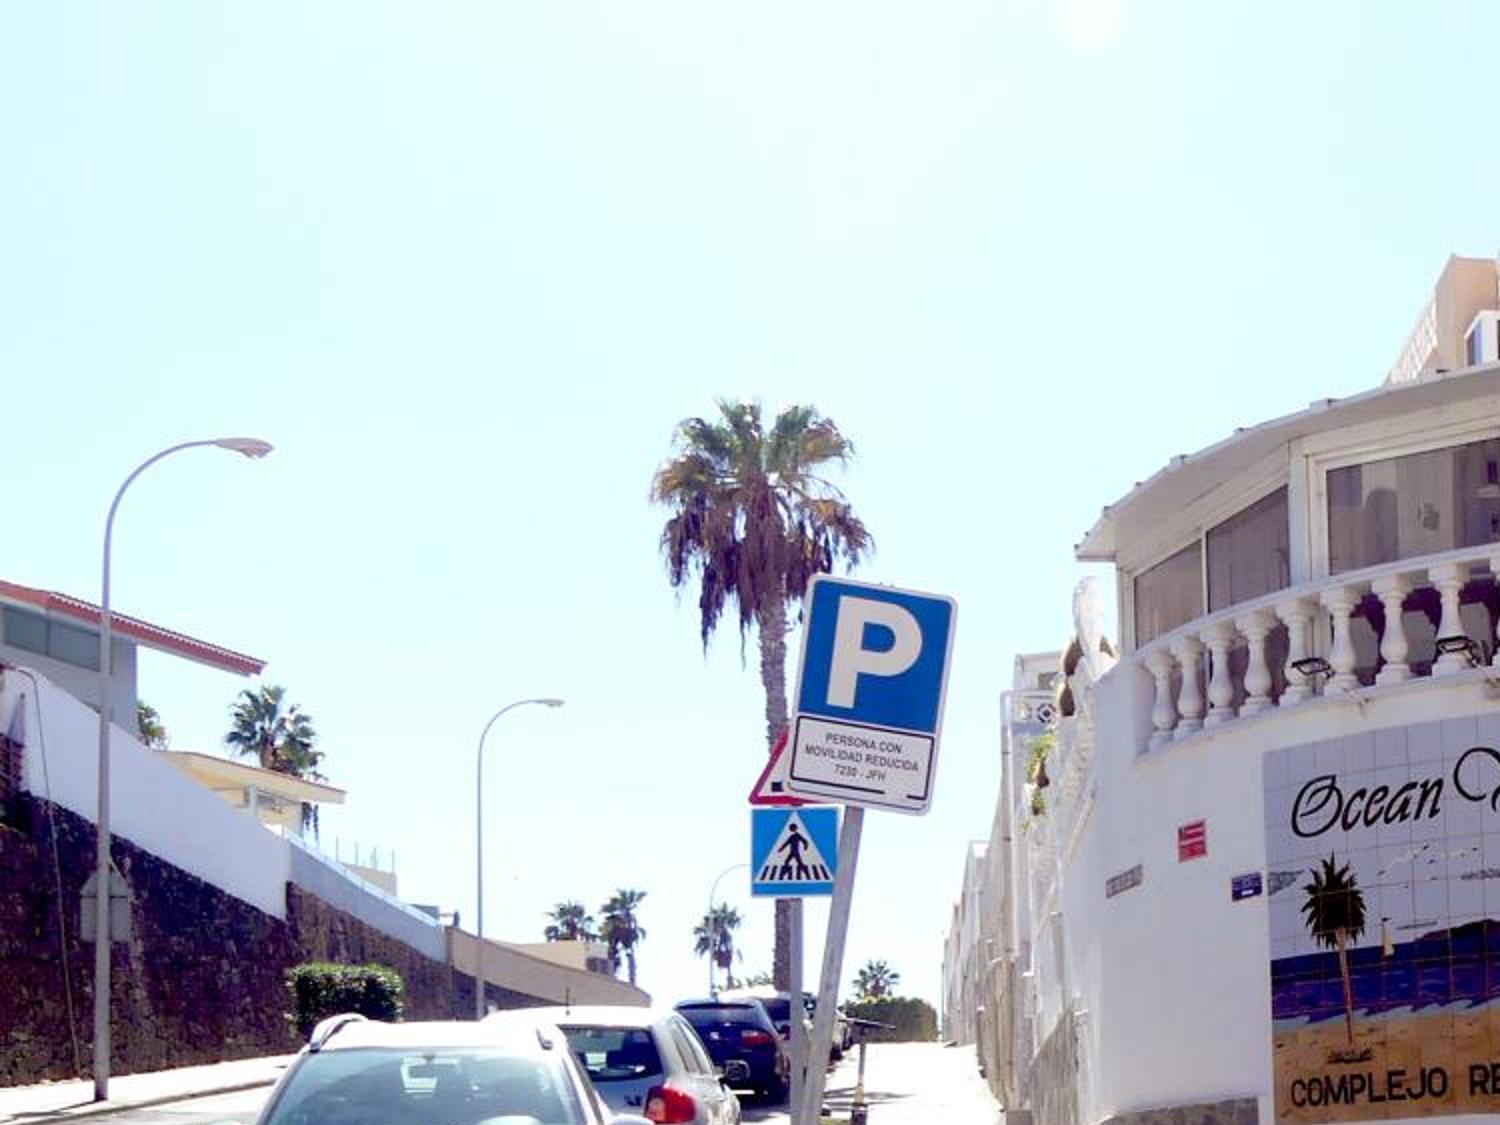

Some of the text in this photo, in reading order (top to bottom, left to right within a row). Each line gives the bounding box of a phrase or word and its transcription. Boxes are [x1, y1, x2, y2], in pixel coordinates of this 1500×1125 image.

[826, 594, 924, 710] P
[805, 744, 919, 771] MOVILIDAD REDUCIDA
[825, 732, 903, 754] PERSONA CON
[1291, 774, 1445, 838] Ocean
[1291, 1066, 1448, 1107] COMPLEJO
